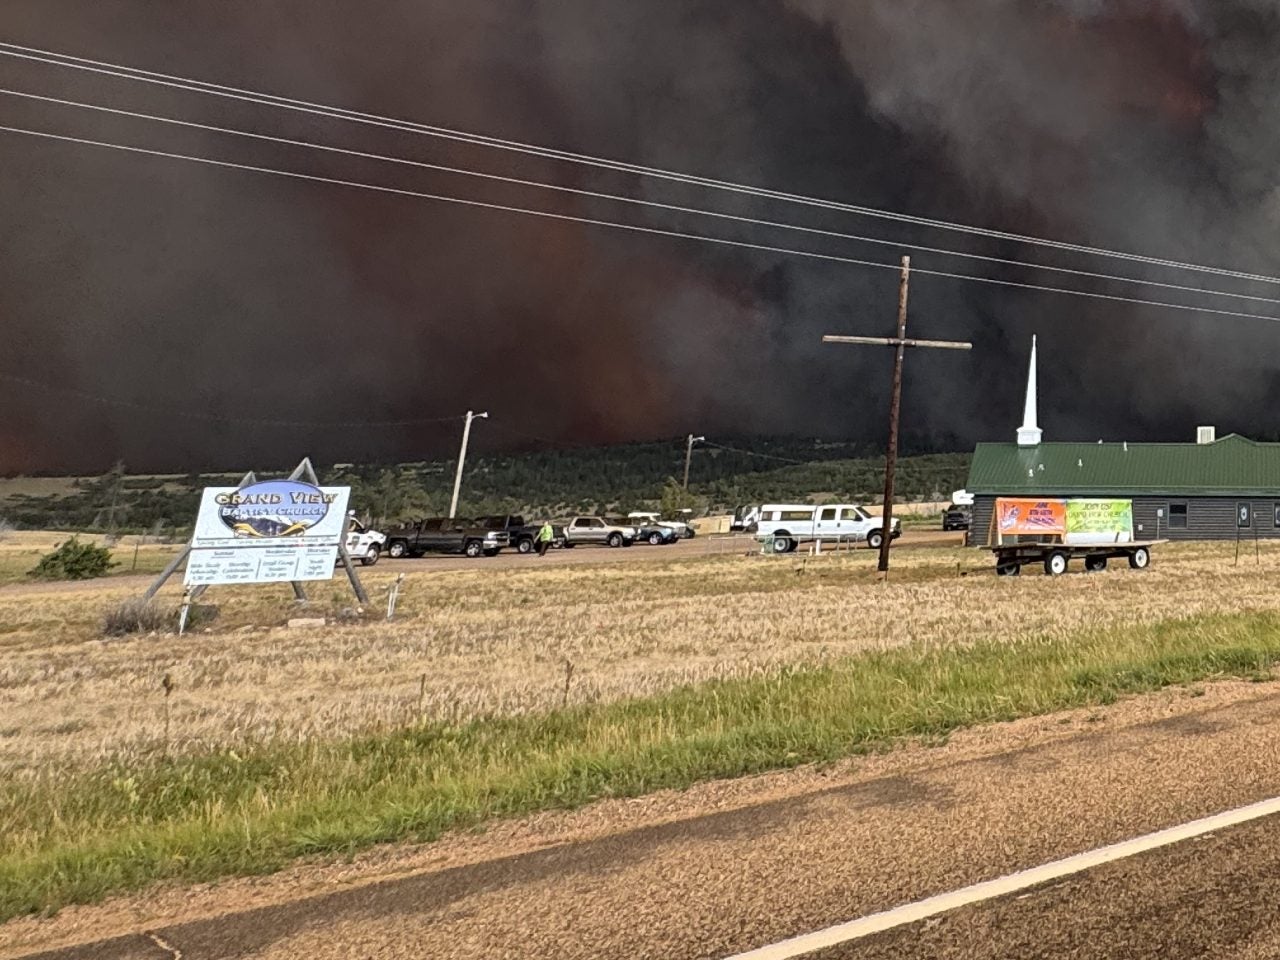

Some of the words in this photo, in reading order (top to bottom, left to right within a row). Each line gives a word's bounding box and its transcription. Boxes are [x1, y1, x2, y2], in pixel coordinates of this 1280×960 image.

[215, 493, 281, 505] GRAND
[289, 491, 338, 504] VIEW
[222, 507, 272, 516] BAPTIST
[276, 507, 325, 516] CHURCH
